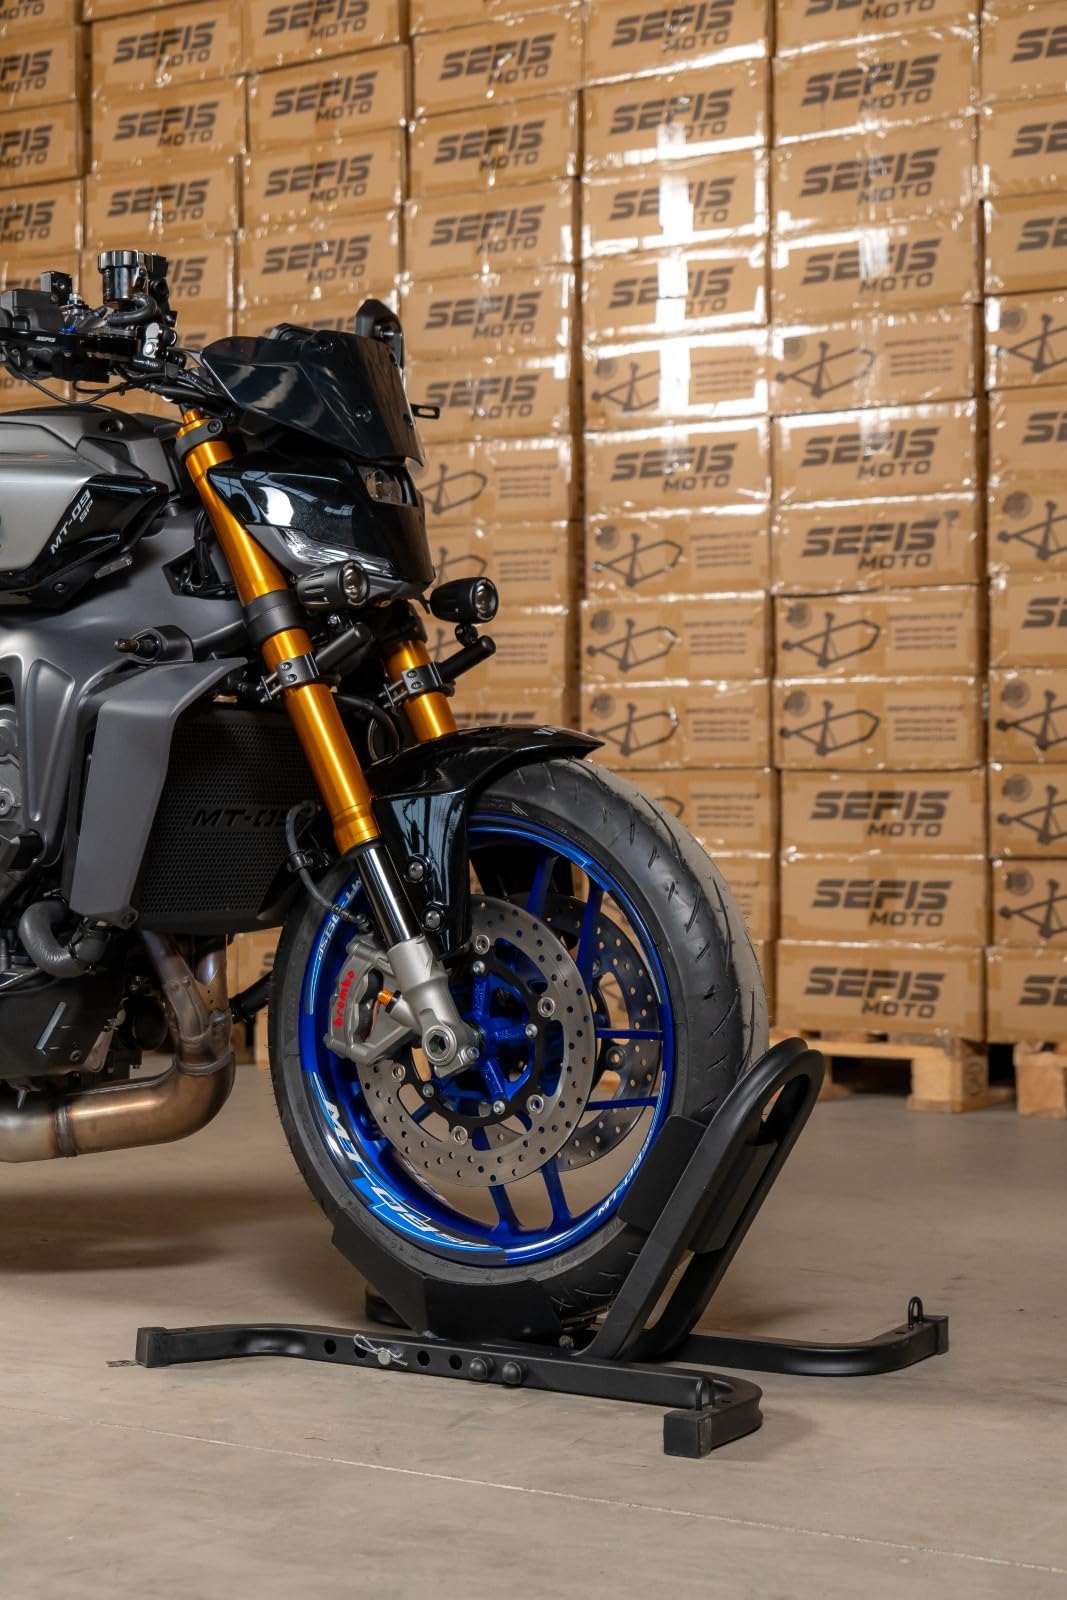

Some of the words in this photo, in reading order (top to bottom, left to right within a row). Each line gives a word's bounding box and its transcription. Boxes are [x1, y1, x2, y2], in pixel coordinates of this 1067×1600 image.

[263, 0, 370, 36] SEFIS
[611, 0, 735, 47] SEFIS
[862, 0, 935, 22] MOTO
[113, 21, 216, 64] SEFIS
[308, 17, 367, 41] MOTO
[662, 29, 730, 53] MOTO
[0, 48, 53, 80] FIS
[156, 52, 210, 69] MOTO
[439, 33, 557, 81] SEFIS
[487, 63, 549, 87] MOTO
[802, 54, 941, 107] SEFIS
[270, 71, 378, 118] SEFIS
[858, 88, 933, 114] MOTO
[114, 101, 219, 141] SEFIS
[315, 102, 373, 121] MOTO
[609, 88, 735, 136] SEFIS
[0, 125, 53, 156] FIS
[158, 129, 213, 147] MOTO
[432, 120, 545, 166] SEFIS
[684, 120, 728, 140] OTO
[264, 153, 373, 198] SEFIS
[479, 151, 539, 172] MOTO
[800, 147, 941, 198] SEFIS
[107, 179, 210, 218] SEFIS
[308, 184, 367, 203] MOTO
[609, 176, 737, 222] SEIS
[857, 183, 933, 206] MOTO
[0, 201, 55, 231] FIS
[162, 208, 204, 225] OTO
[429, 205, 545, 247] SEFIS
[261, 234, 372, 275] SEFIS
[476, 235, 538, 254] MOTO
[306, 264, 367, 283] MOTO
[802, 238, 942, 286] SEIS
[608, 266, 735, 310] SEIS
[858, 271, 934, 295] MOTO
[424, 291, 542, 330] SEFIS
[684, 297, 728, 315] OTO
[473, 320, 536, 339] MOTO
[424, 374, 541, 409] SEFIS
[471, 403, 534, 421] MOTO
[611, 443, 737, 482] SEFIS
[801, 427, 940, 467] SEFIS
[663, 474, 730, 493] MOTO
[857, 460, 932, 479] MOTO
[50, 489, 91, 555] MT-09
[802, 519, 940, 558] SEFIS
[857, 553, 932, 571] MOTO
[810, 790, 952, 821] SEFIS
[867, 822, 942, 837] MOTO
[811, 879, 953, 910] SEFIS
[869, 911, 943, 927] MOTO
[804, 966, 945, 1002] SEFIS
[861, 1001, 936, 1019] MOTO
